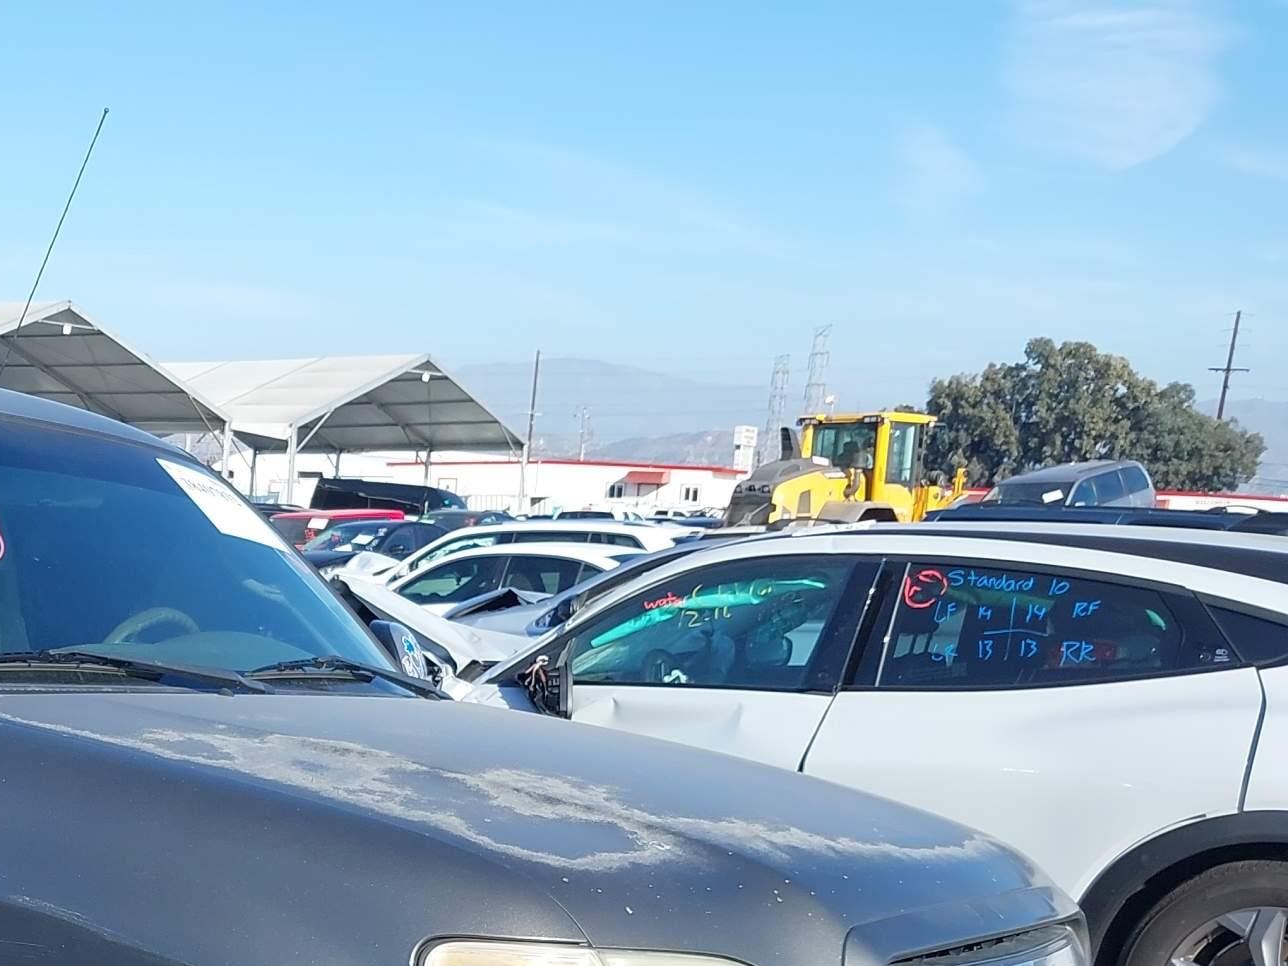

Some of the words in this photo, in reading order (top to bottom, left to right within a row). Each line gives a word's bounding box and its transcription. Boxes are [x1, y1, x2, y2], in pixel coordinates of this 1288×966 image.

[947, 569, 1035, 592] Standard
[1048, 578, 1070, 595] 10
[1026, 603, 1046, 623] 14
[1072, 600, 1102, 618] RF
[978, 640, 993, 660] 13
[1020, 640, 1038, 657] 13
